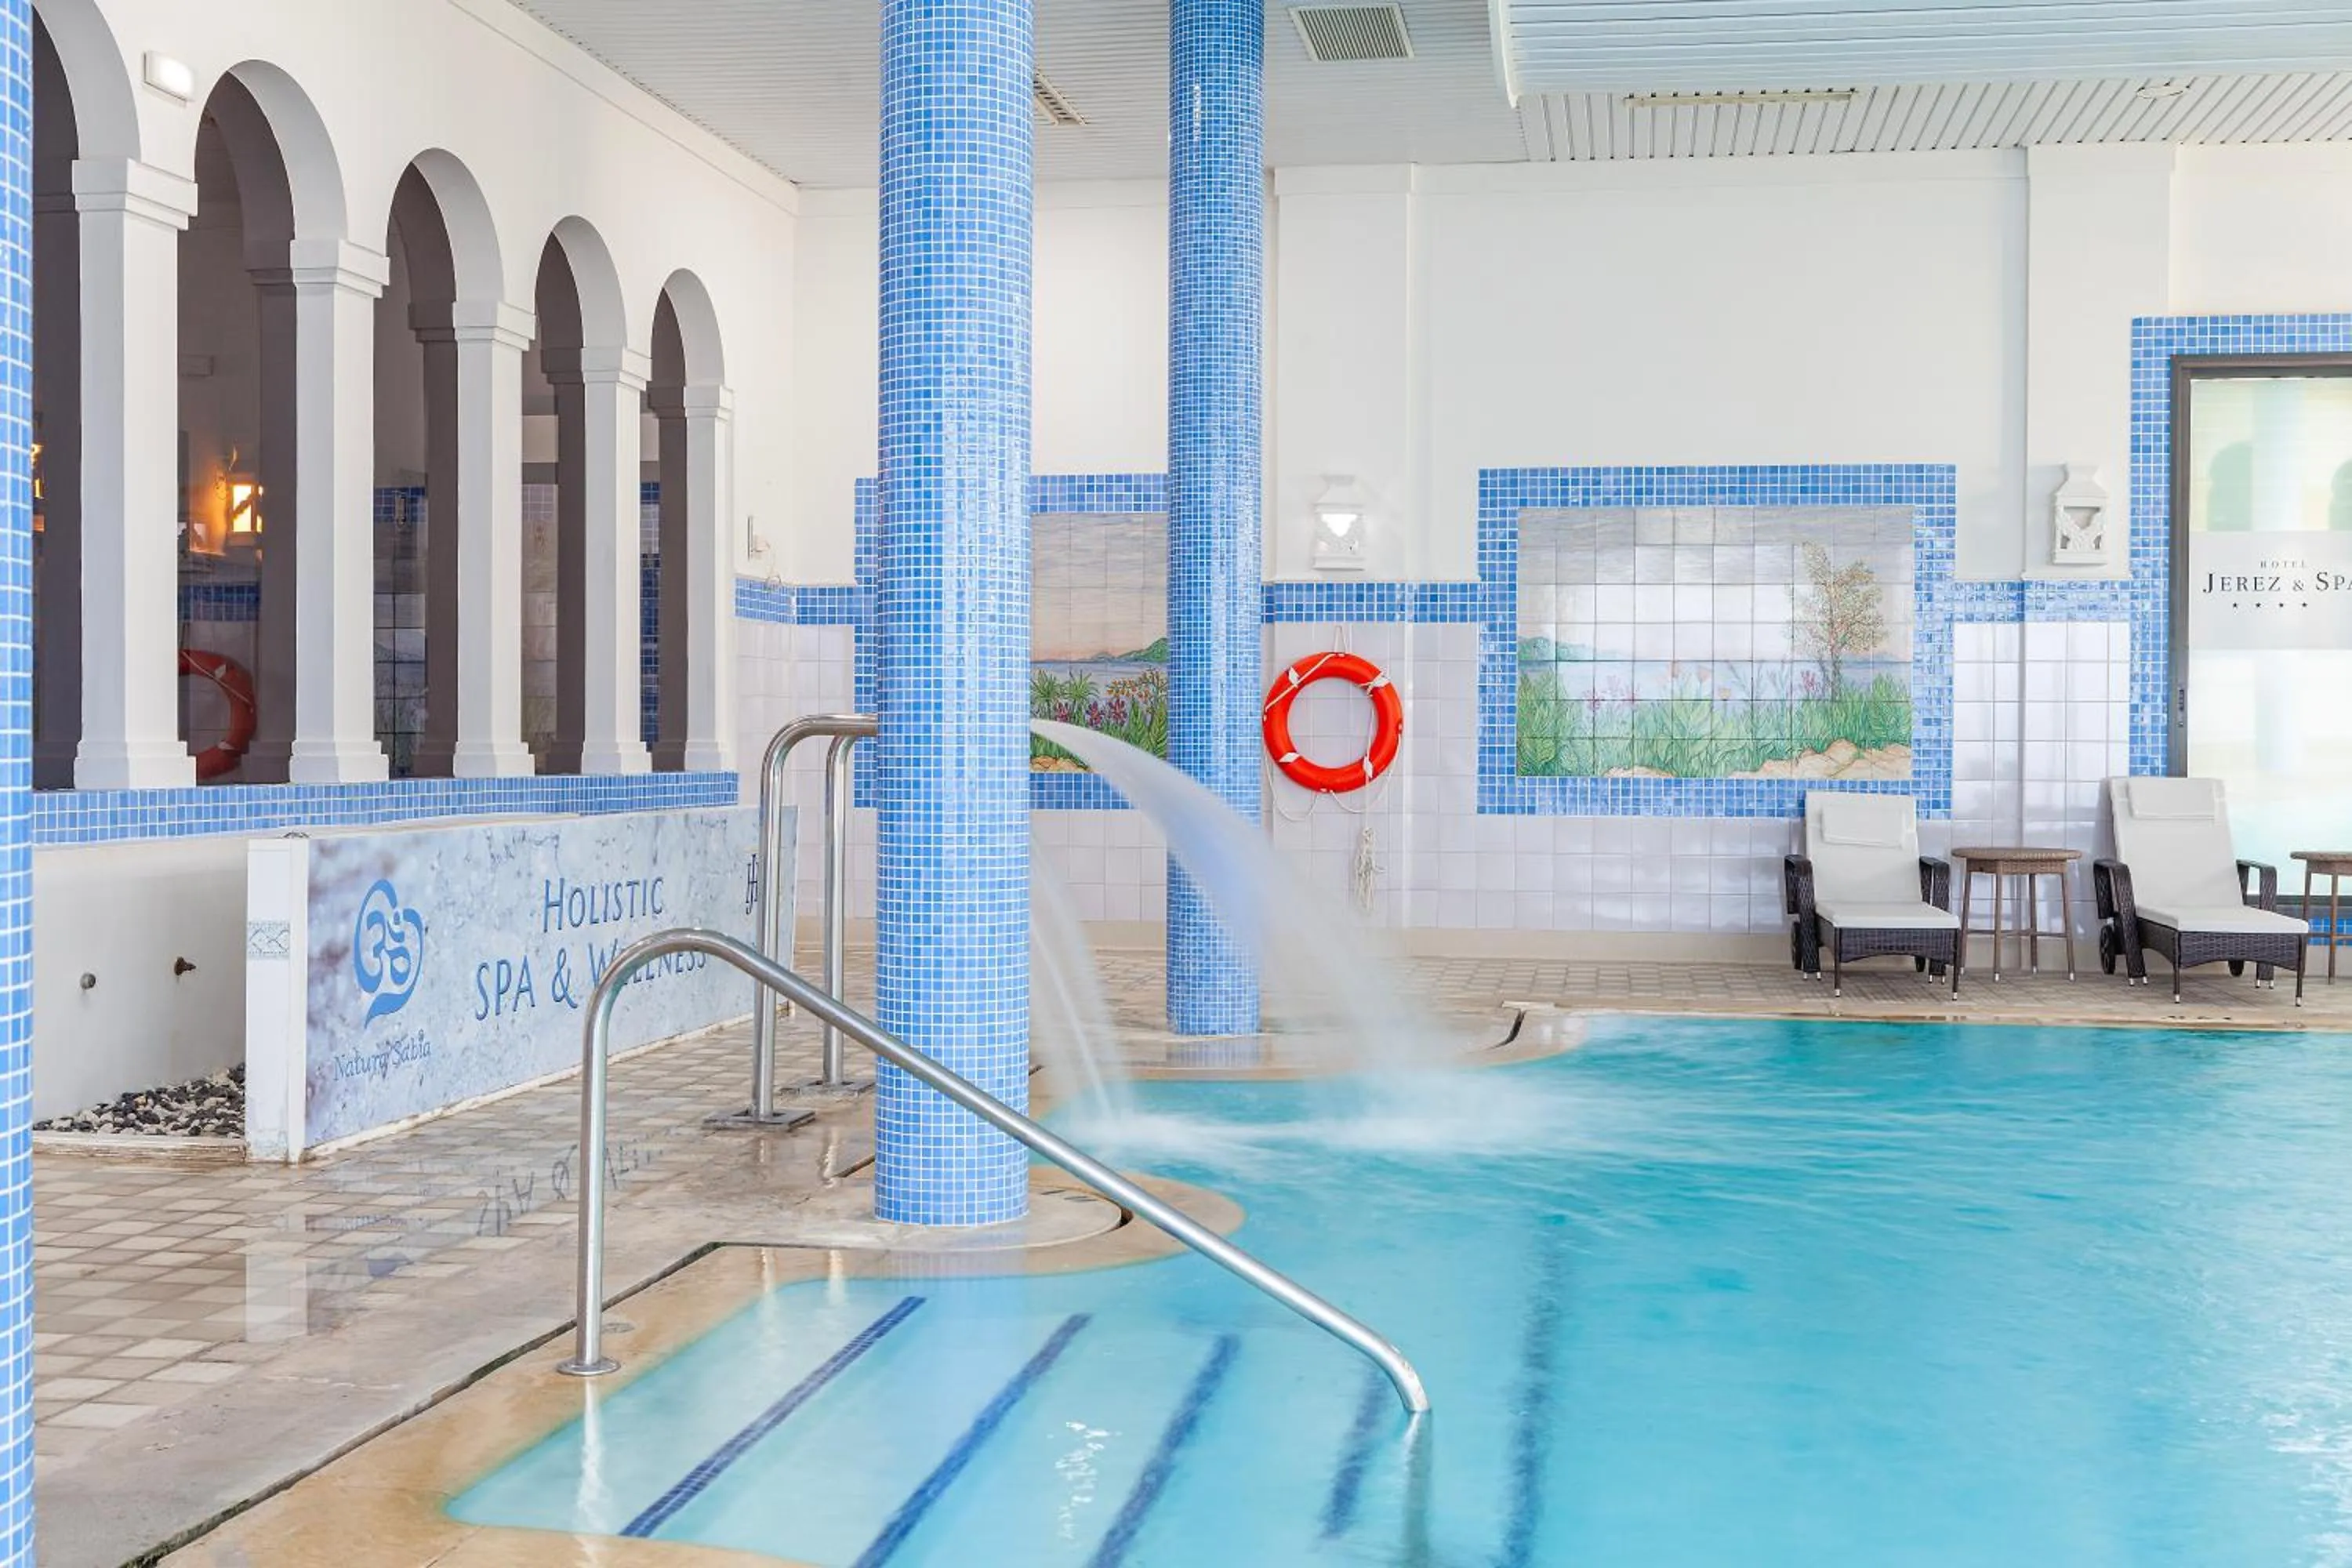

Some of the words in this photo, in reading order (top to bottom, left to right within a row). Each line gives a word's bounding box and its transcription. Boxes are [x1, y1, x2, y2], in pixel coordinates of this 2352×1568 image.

[2201, 572, 2281, 593] JEREZ
[2292, 579, 2305, 591] &
[543, 877, 665, 933] HOLISTIC
[474, 954, 536, 1021] SPA
[550, 947, 579, 1009] &
[588, 938, 707, 990] WLLNESS
